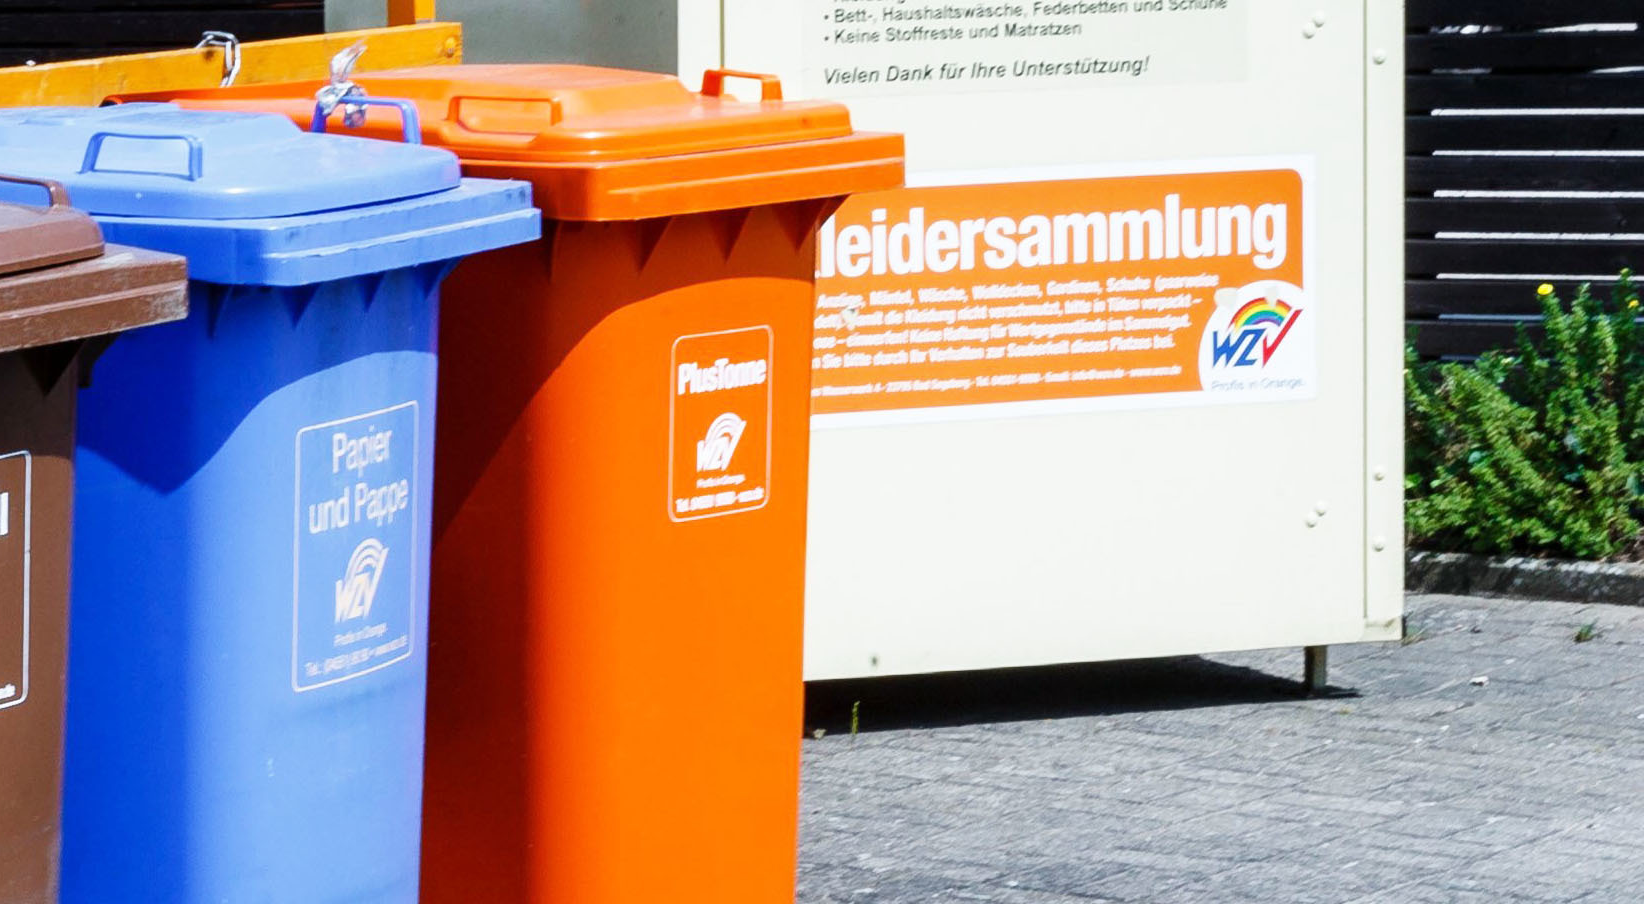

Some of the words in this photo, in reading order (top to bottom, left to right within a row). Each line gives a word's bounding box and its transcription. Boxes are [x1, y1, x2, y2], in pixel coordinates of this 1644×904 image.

[835, 29, 880, 43] Keine
[886, 26, 963, 42] Stoffreste
[969, 25, 998, 38] und
[1005, 23, 1081, 37] Matratzen
[882, 2, 1028, 21] Haushaltswäsche,
[1033, 0, 1128, 15] Federbetten
[1134, 0, 1163, 12] und
[825, 68, 879, 84] Vielen
[886, 64, 933, 82] Dank
[940, 63, 966, 79] für
[971, 62, 1006, 78] Ihre
[1013, 56, 1149, 77] Unterstützung!
[815, 193, 1288, 278] leidersammlung
[1212, 309, 1303, 367] WZV
[677, 358, 767, 396] PlusTonne
[332, 424, 392, 479] Papier
[309, 486, 351, 534] und
[354, 478, 409, 528] Pappe
